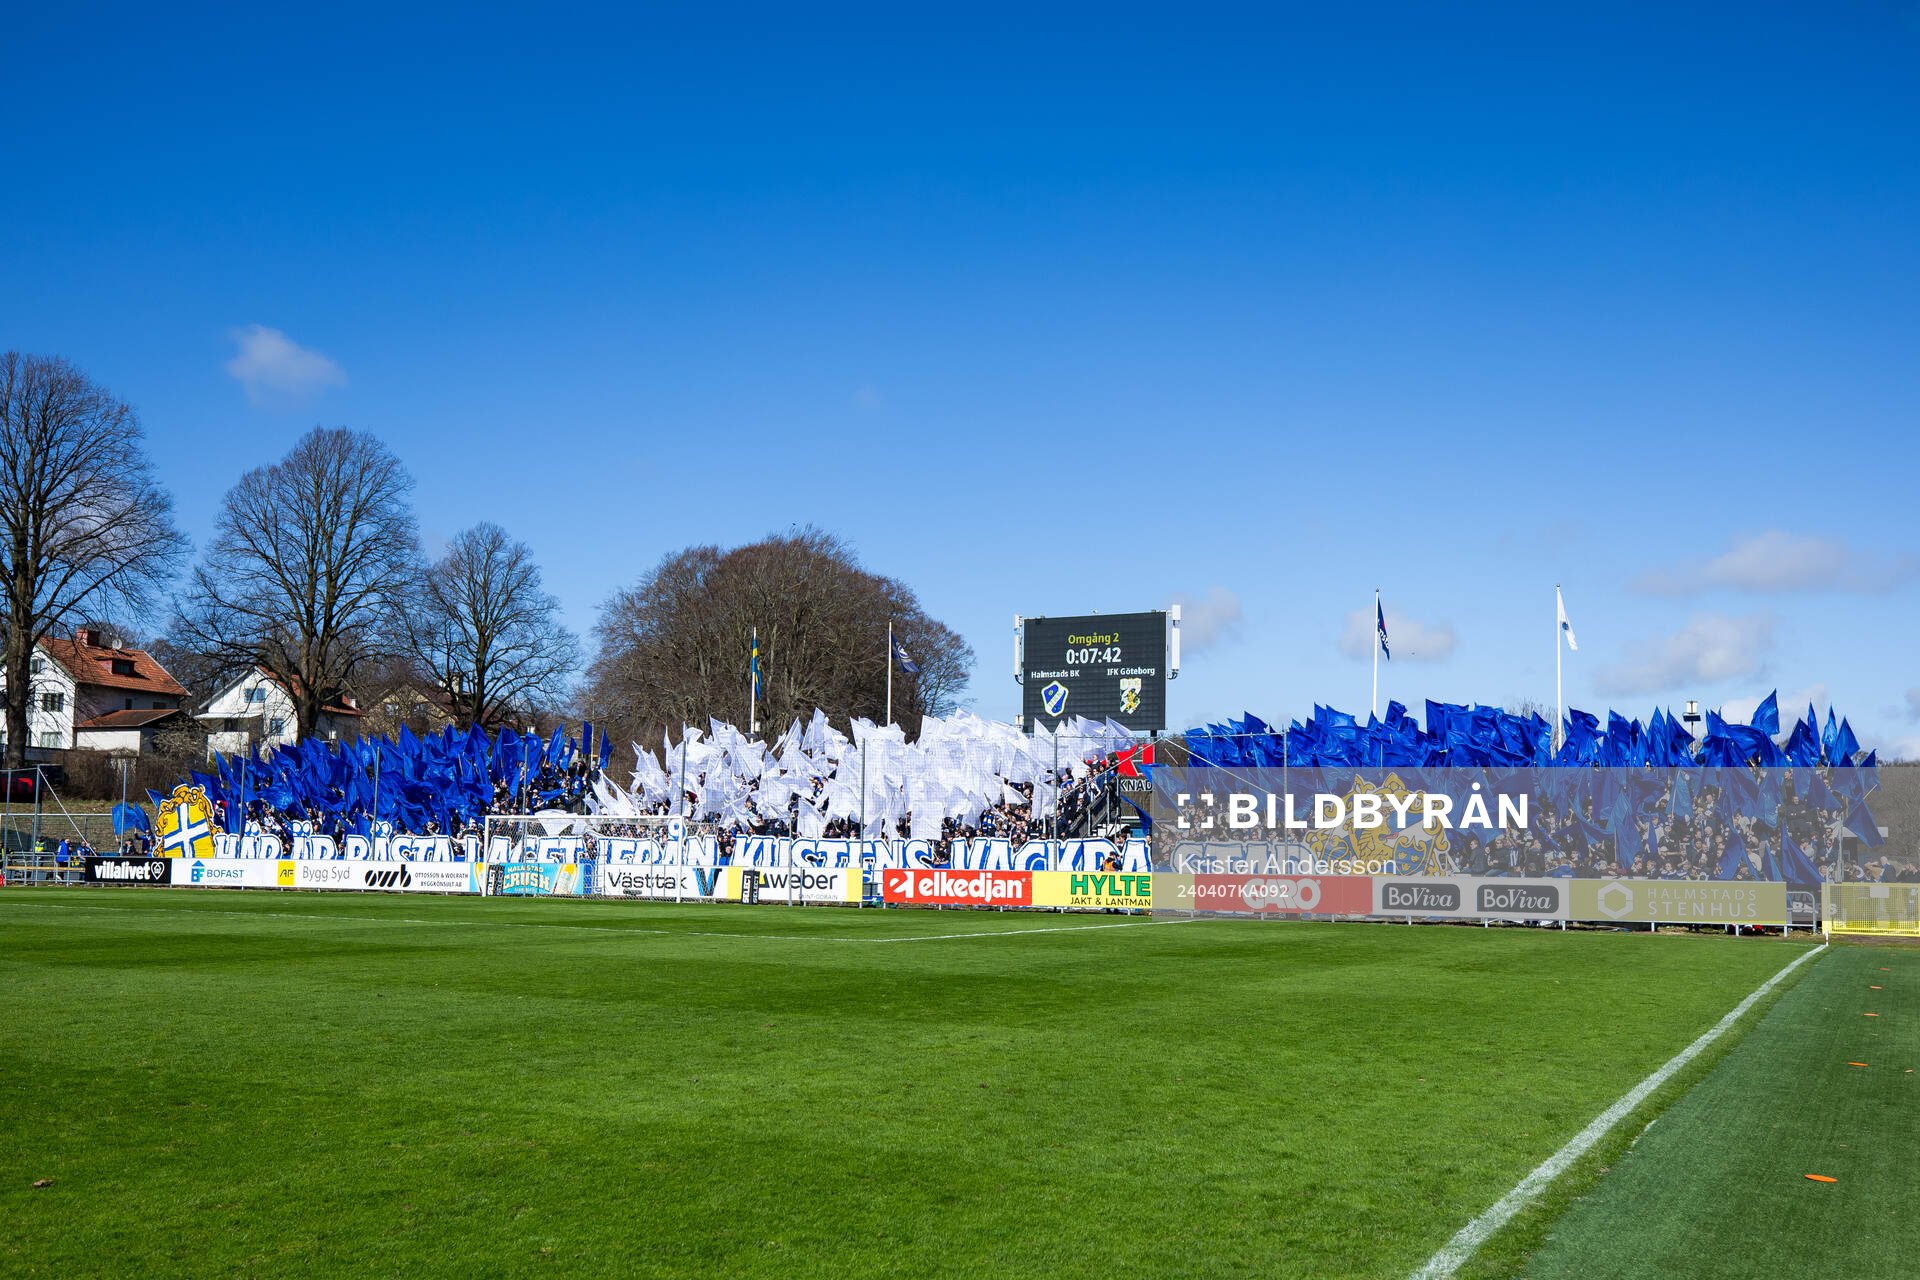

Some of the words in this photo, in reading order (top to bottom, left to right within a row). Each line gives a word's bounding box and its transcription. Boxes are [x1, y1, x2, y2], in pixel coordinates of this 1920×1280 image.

[1068, 632, 1111, 647] Omgång
[1113, 633, 1120, 643] 2
[1066, 647, 1122, 664] 0:07:42
[1031, 670, 1069, 679] Halmstads
[1070, 669, 1080, 678] BK
[1107, 668, 1119, 676] IFK
[1120, 667, 1155, 677] Göteborg
[94, 861, 151, 880] villalivet
[207, 869, 244, 878] BOFAST
[279, 869, 294, 878] AF
[302, 866, 328, 882] Bygg
[331, 866, 350, 881] Syd
[503, 872, 550, 891] CRUSH
[608, 872, 688, 890] Västtak
[770, 869, 838, 890] weber
[918, 872, 1023, 903] elkedjan
[1071, 874, 1151, 897] HYLTE
[742, 875, 751, 904] SELECT
[1388, 887, 1454, 908] BoViva
[1648, 888, 1757, 901] HALMSTADS
[1070, 897, 1092, 905] JAKT
[1095, 898, 1102, 906] &
[1106, 898, 1151, 906] LANTMAN
[1483, 889, 1552, 909] BoViva
[1648, 901, 1757, 918] STENHUS
